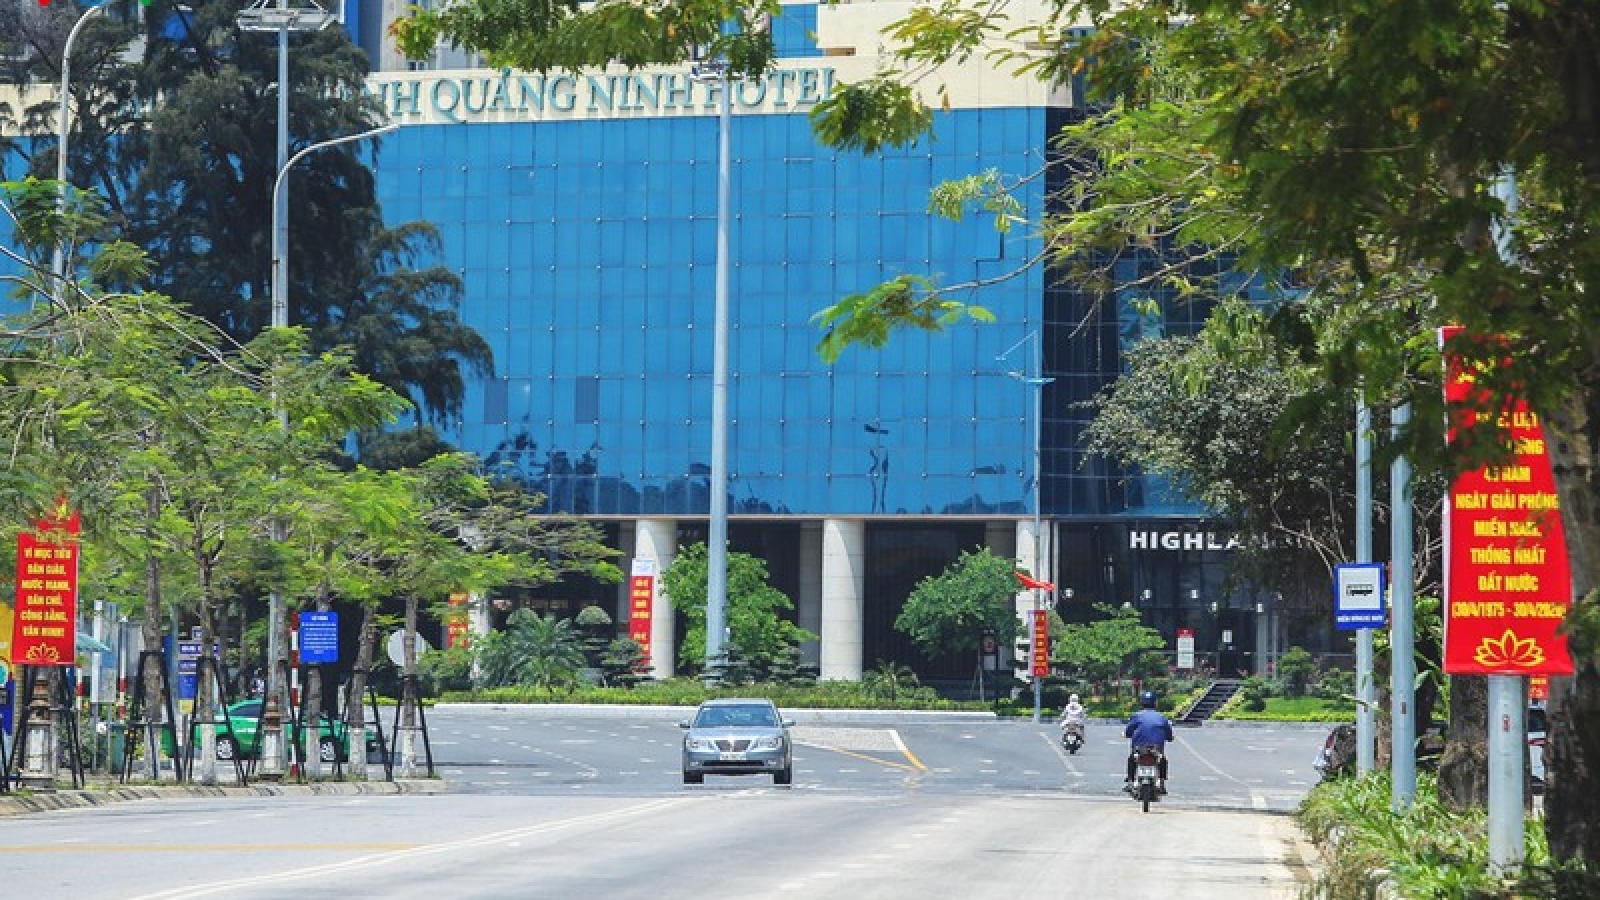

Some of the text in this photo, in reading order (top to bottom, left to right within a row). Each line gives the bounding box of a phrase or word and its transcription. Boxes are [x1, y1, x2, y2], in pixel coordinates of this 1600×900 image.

[429, 66, 574, 123] QUẢNG
[586, 70, 693, 114] NINH
[1456, 488, 1560, 510] NGÀY GIẢI PHÓNG
[1470, 543, 1546, 565] THỐNG NHẤT
[1505, 572, 1539, 592] NƯỚC
